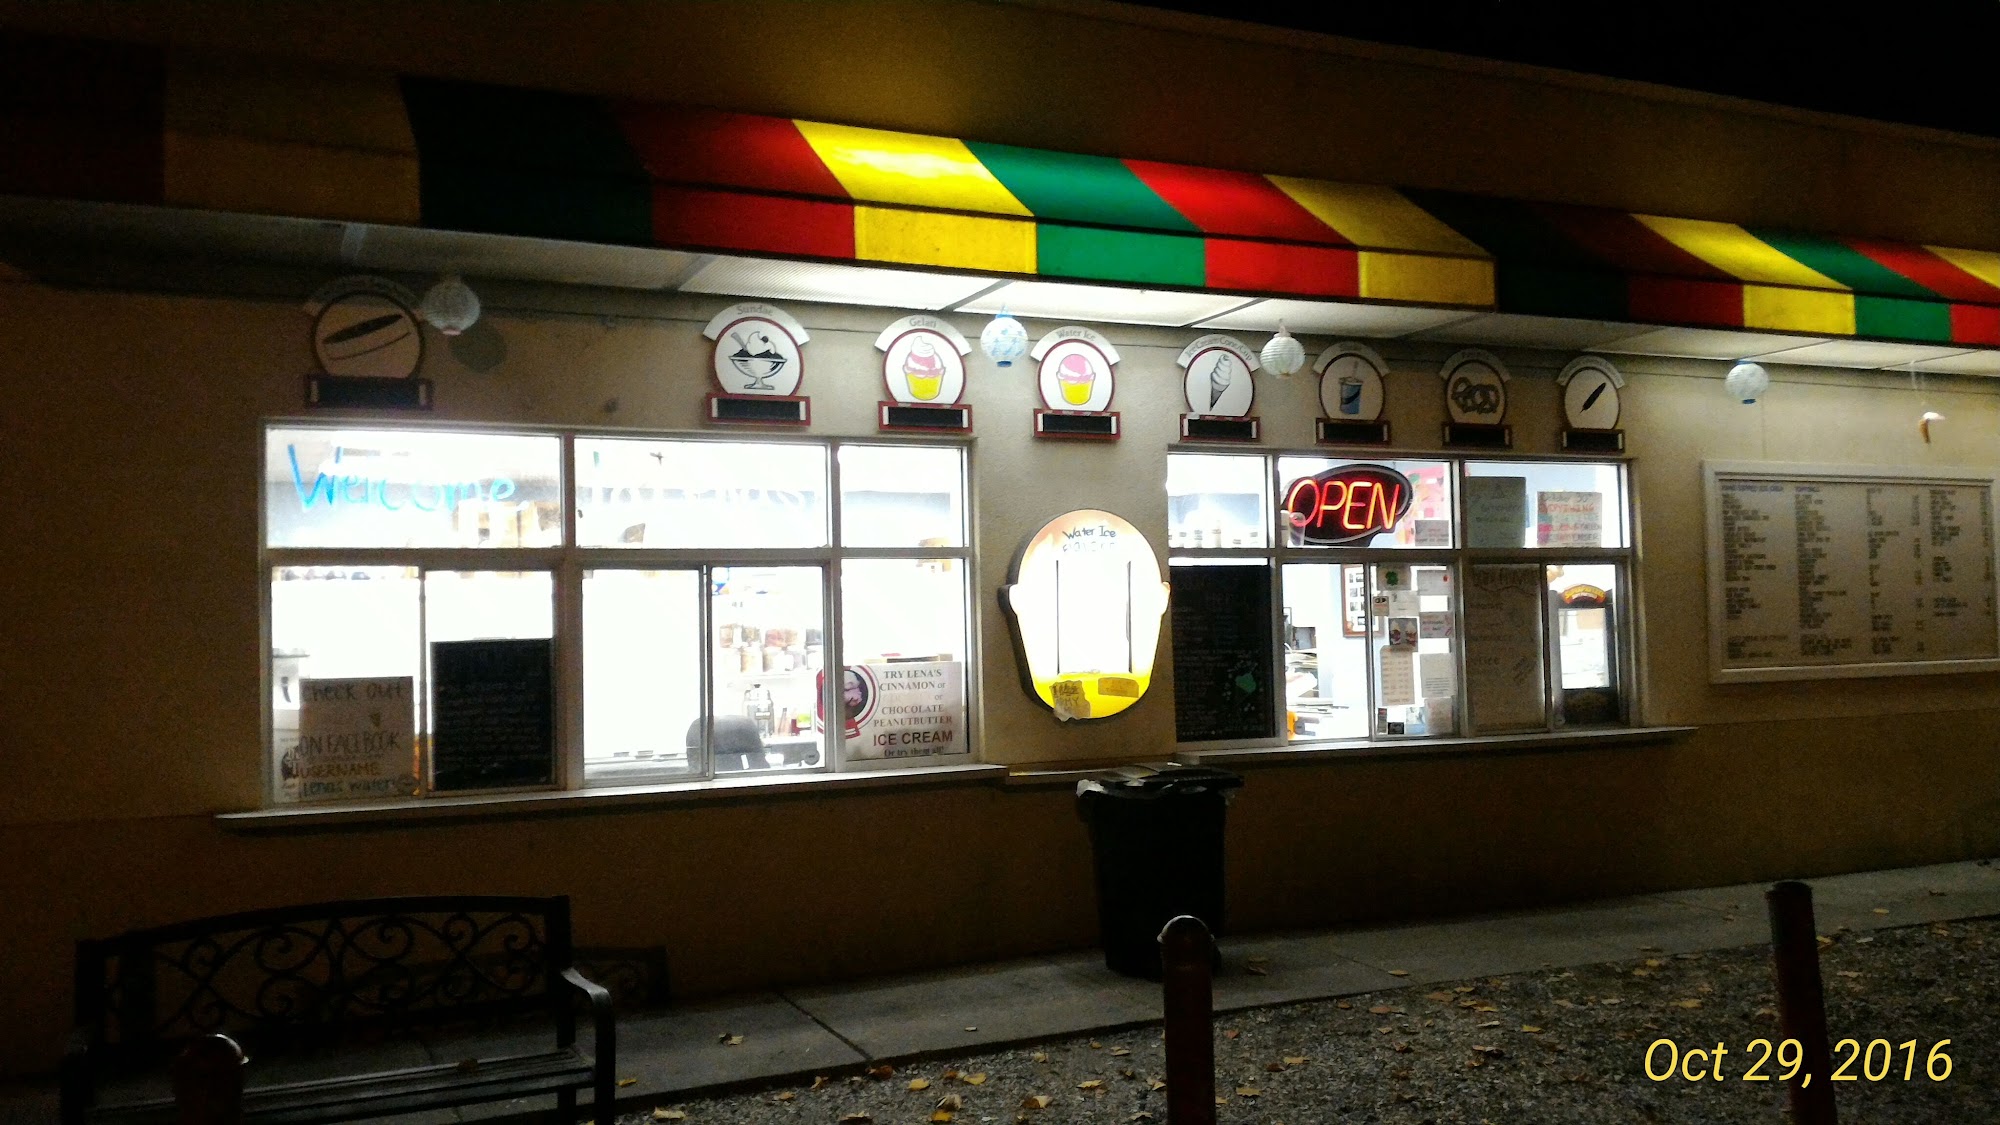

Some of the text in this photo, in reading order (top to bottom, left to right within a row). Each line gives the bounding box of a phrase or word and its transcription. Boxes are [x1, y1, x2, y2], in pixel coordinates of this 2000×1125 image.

[736, 304, 774, 317] Sundae
[1056, 328, 1096, 341] Water Ice
[286, 443, 516, 513] Welcome
[1287, 478, 1401, 530] OPEN
[1062, 524, 1117, 540] Water Ice
[884, 669, 942, 679] TRY LENA'S
[880, 681, 935, 691] CINNAMON
[881, 704, 944, 715] CHOCOLATE
[873, 716, 952, 727] PEANUTBUTTER
[873, 730, 953, 746] ICE CREAM
